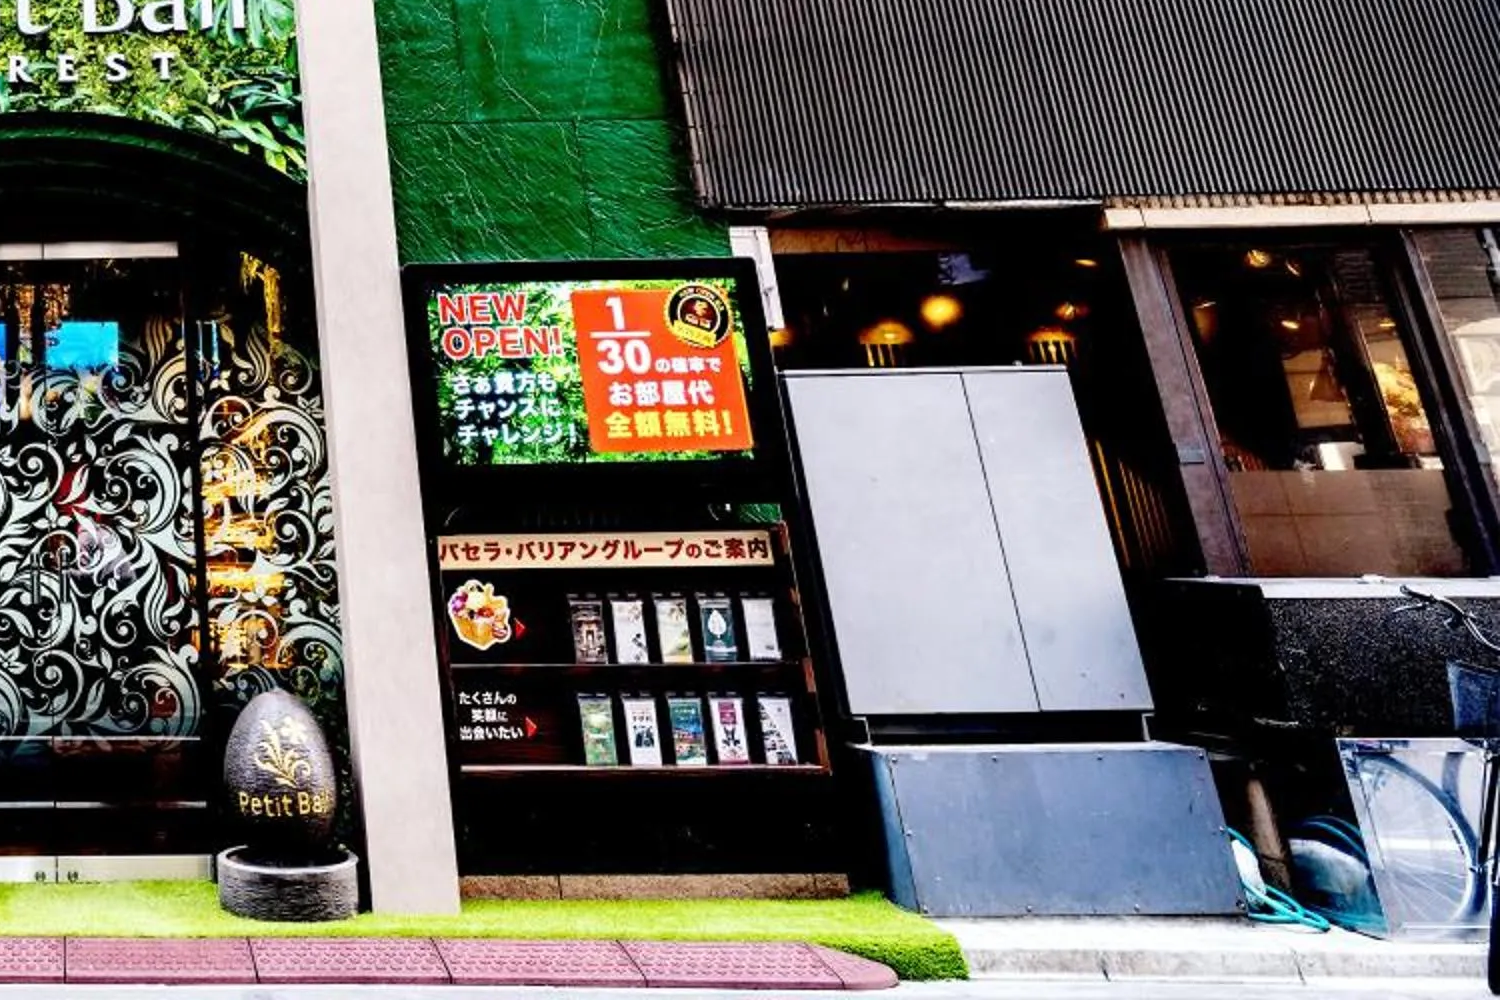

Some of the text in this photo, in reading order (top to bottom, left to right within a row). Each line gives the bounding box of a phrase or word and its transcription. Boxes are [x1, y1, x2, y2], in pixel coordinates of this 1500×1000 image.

[438, 291, 528, 325] NEW
[604, 295, 627, 332] 1
[442, 325, 564, 360] OPEN!
[458, 690, 518, 705] たくさんの
[238, 791, 293, 817] Petit
